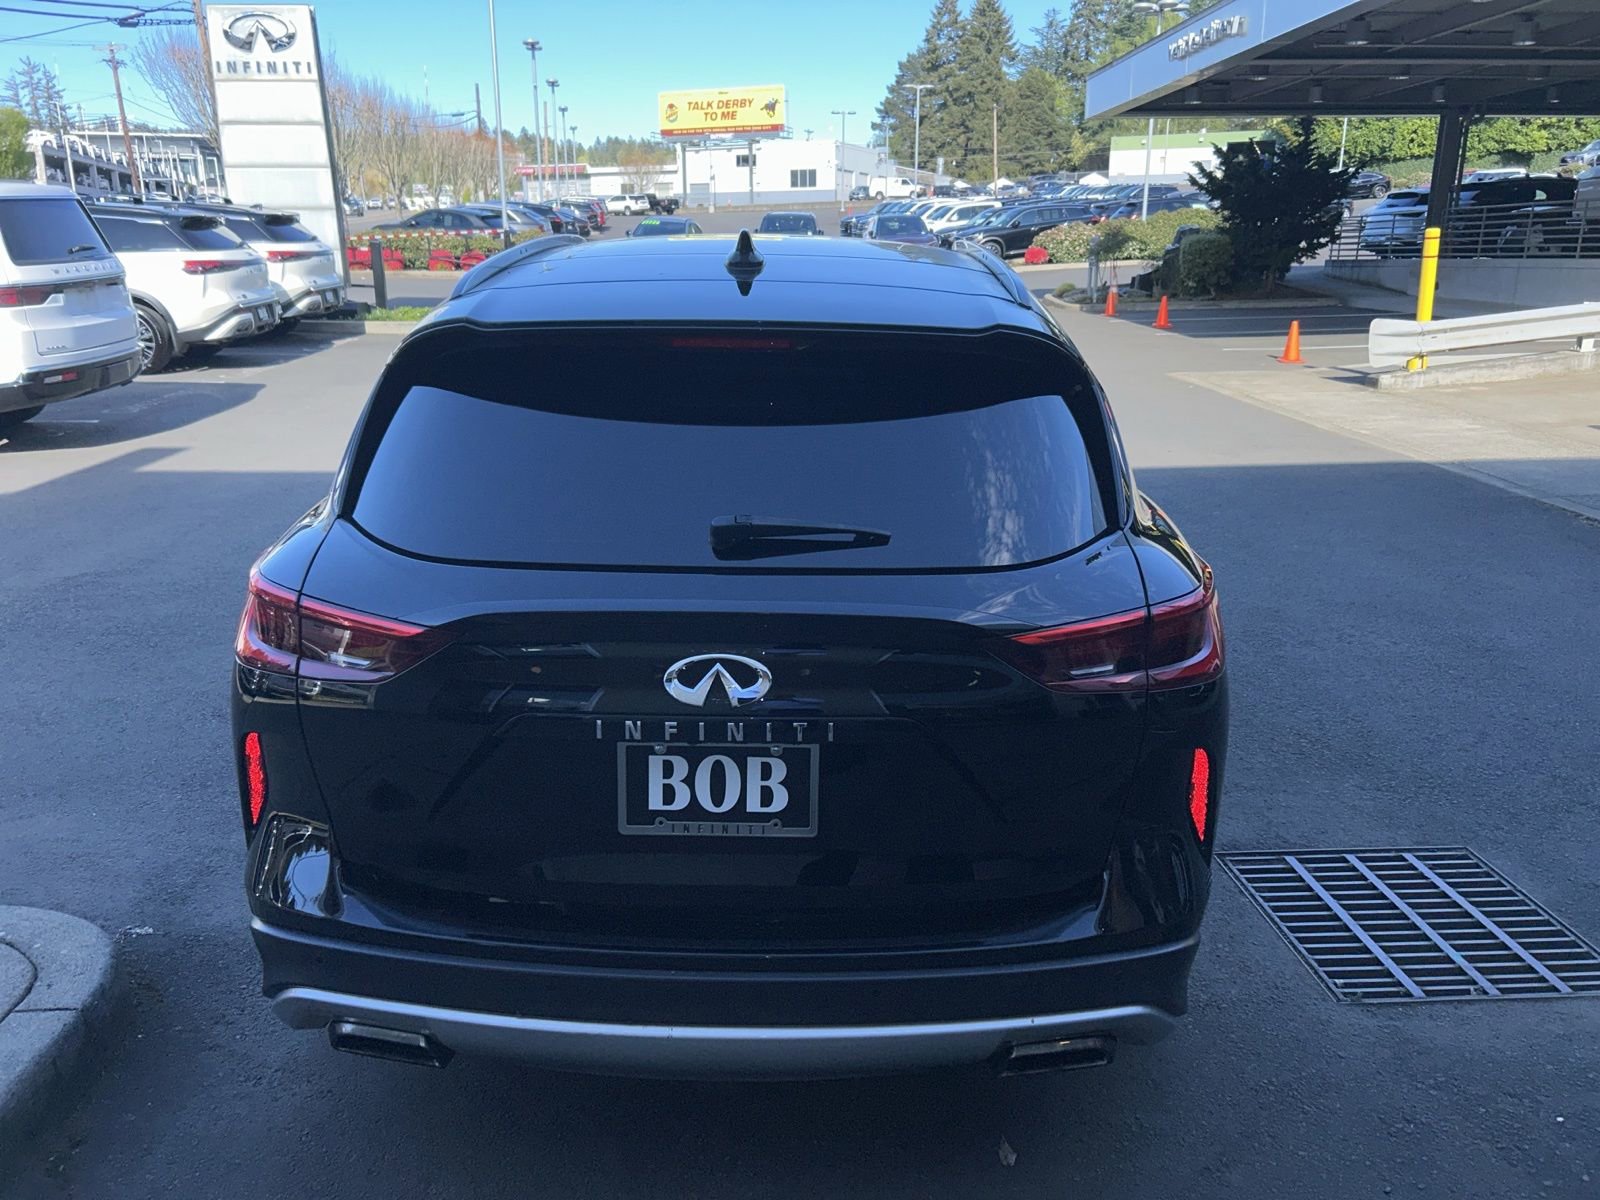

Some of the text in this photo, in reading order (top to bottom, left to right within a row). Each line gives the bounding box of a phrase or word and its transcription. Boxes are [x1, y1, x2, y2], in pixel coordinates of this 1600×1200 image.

[216, 61, 312, 74] INFINITI
[687, 98, 755, 111] TALK DERBY
[703, 110, 738, 122] TO ME
[596, 719, 834, 742] INFINITI
[648, 754, 789, 813] BOB
[671, 823, 766, 835] INFINITI
